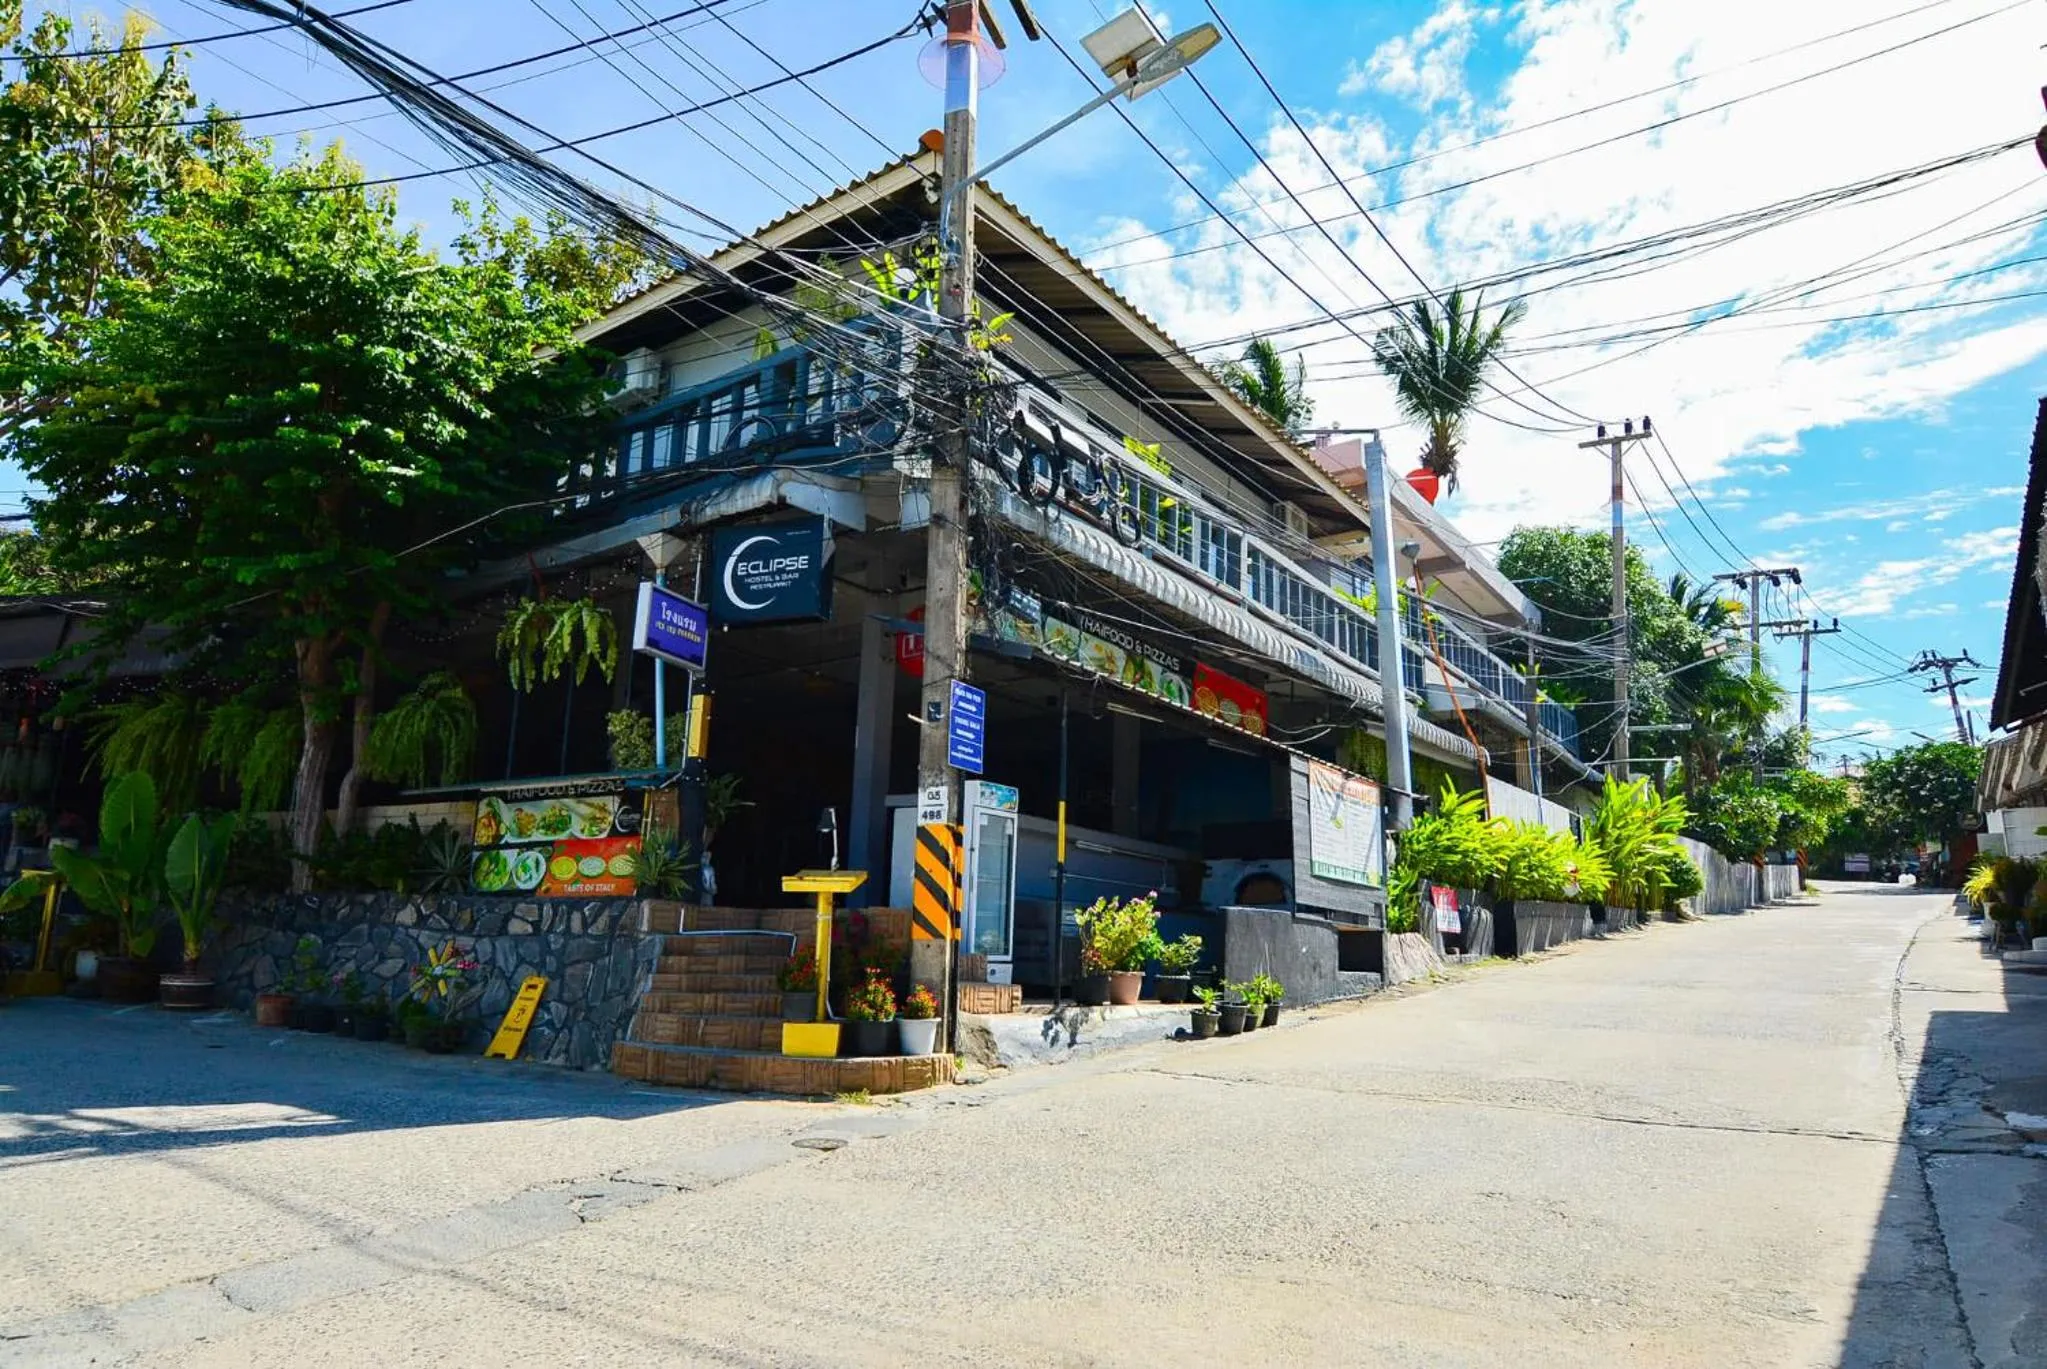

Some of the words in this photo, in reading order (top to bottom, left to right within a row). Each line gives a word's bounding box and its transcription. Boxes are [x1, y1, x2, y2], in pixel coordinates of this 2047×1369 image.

[737, 555, 809, 575] ECLIPSE
[744, 574, 772, 583] HOSTEL
[661, 601, 697, 632] โรงแรม
[1143, 643, 1180, 671] PIZZAS
